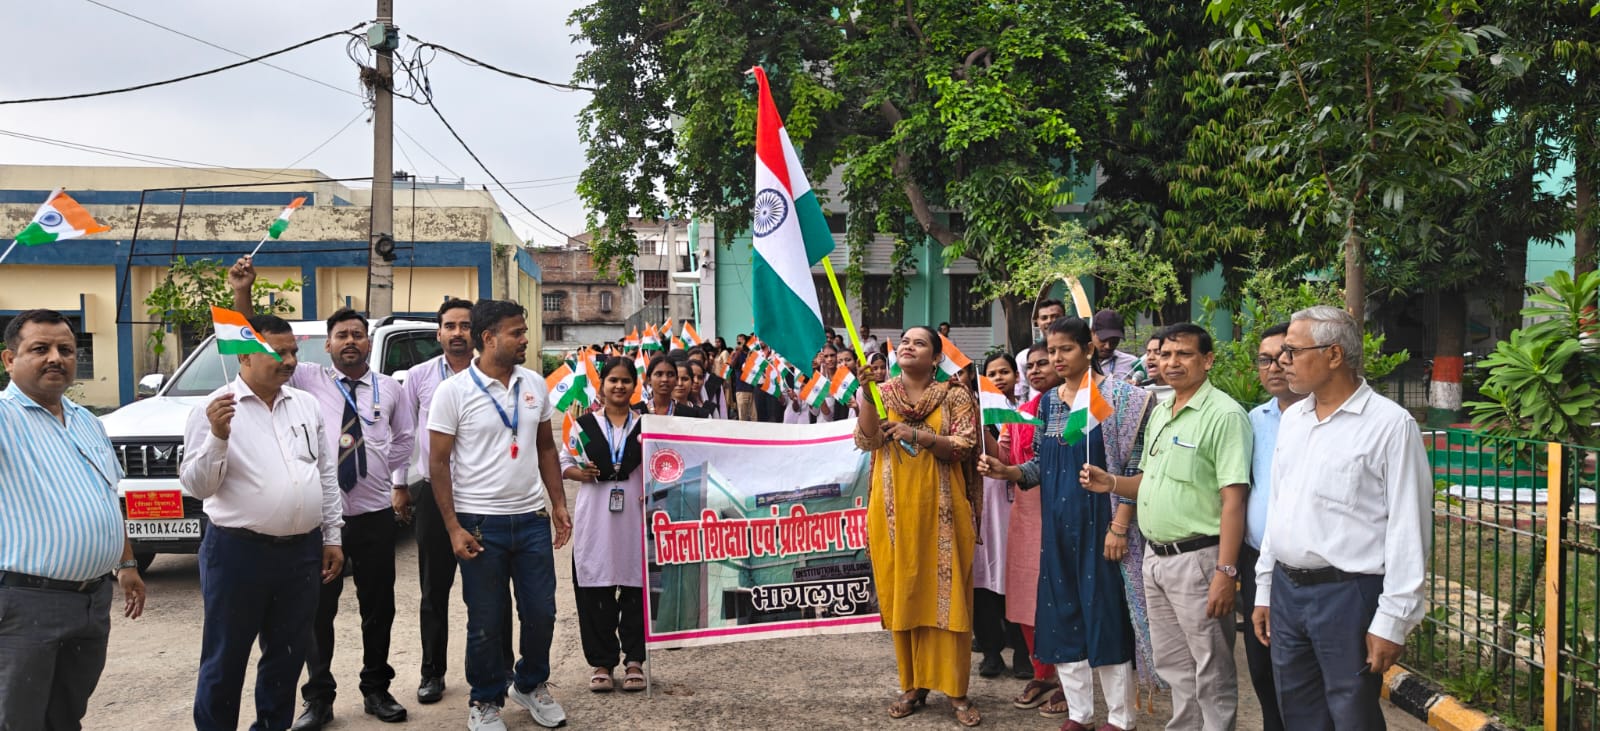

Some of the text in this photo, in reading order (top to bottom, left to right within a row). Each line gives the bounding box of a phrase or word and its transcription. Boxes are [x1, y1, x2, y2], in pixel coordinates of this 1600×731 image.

[128, 522, 199, 535] BR10AX4462
[652, 511, 702, 564] जिला
[702, 509, 749, 561] शिक्षा
[750, 505, 777, 556] एवं
[779, 504, 844, 558] प्रशिक्षण
[751, 577, 869, 614] भागलपुर
